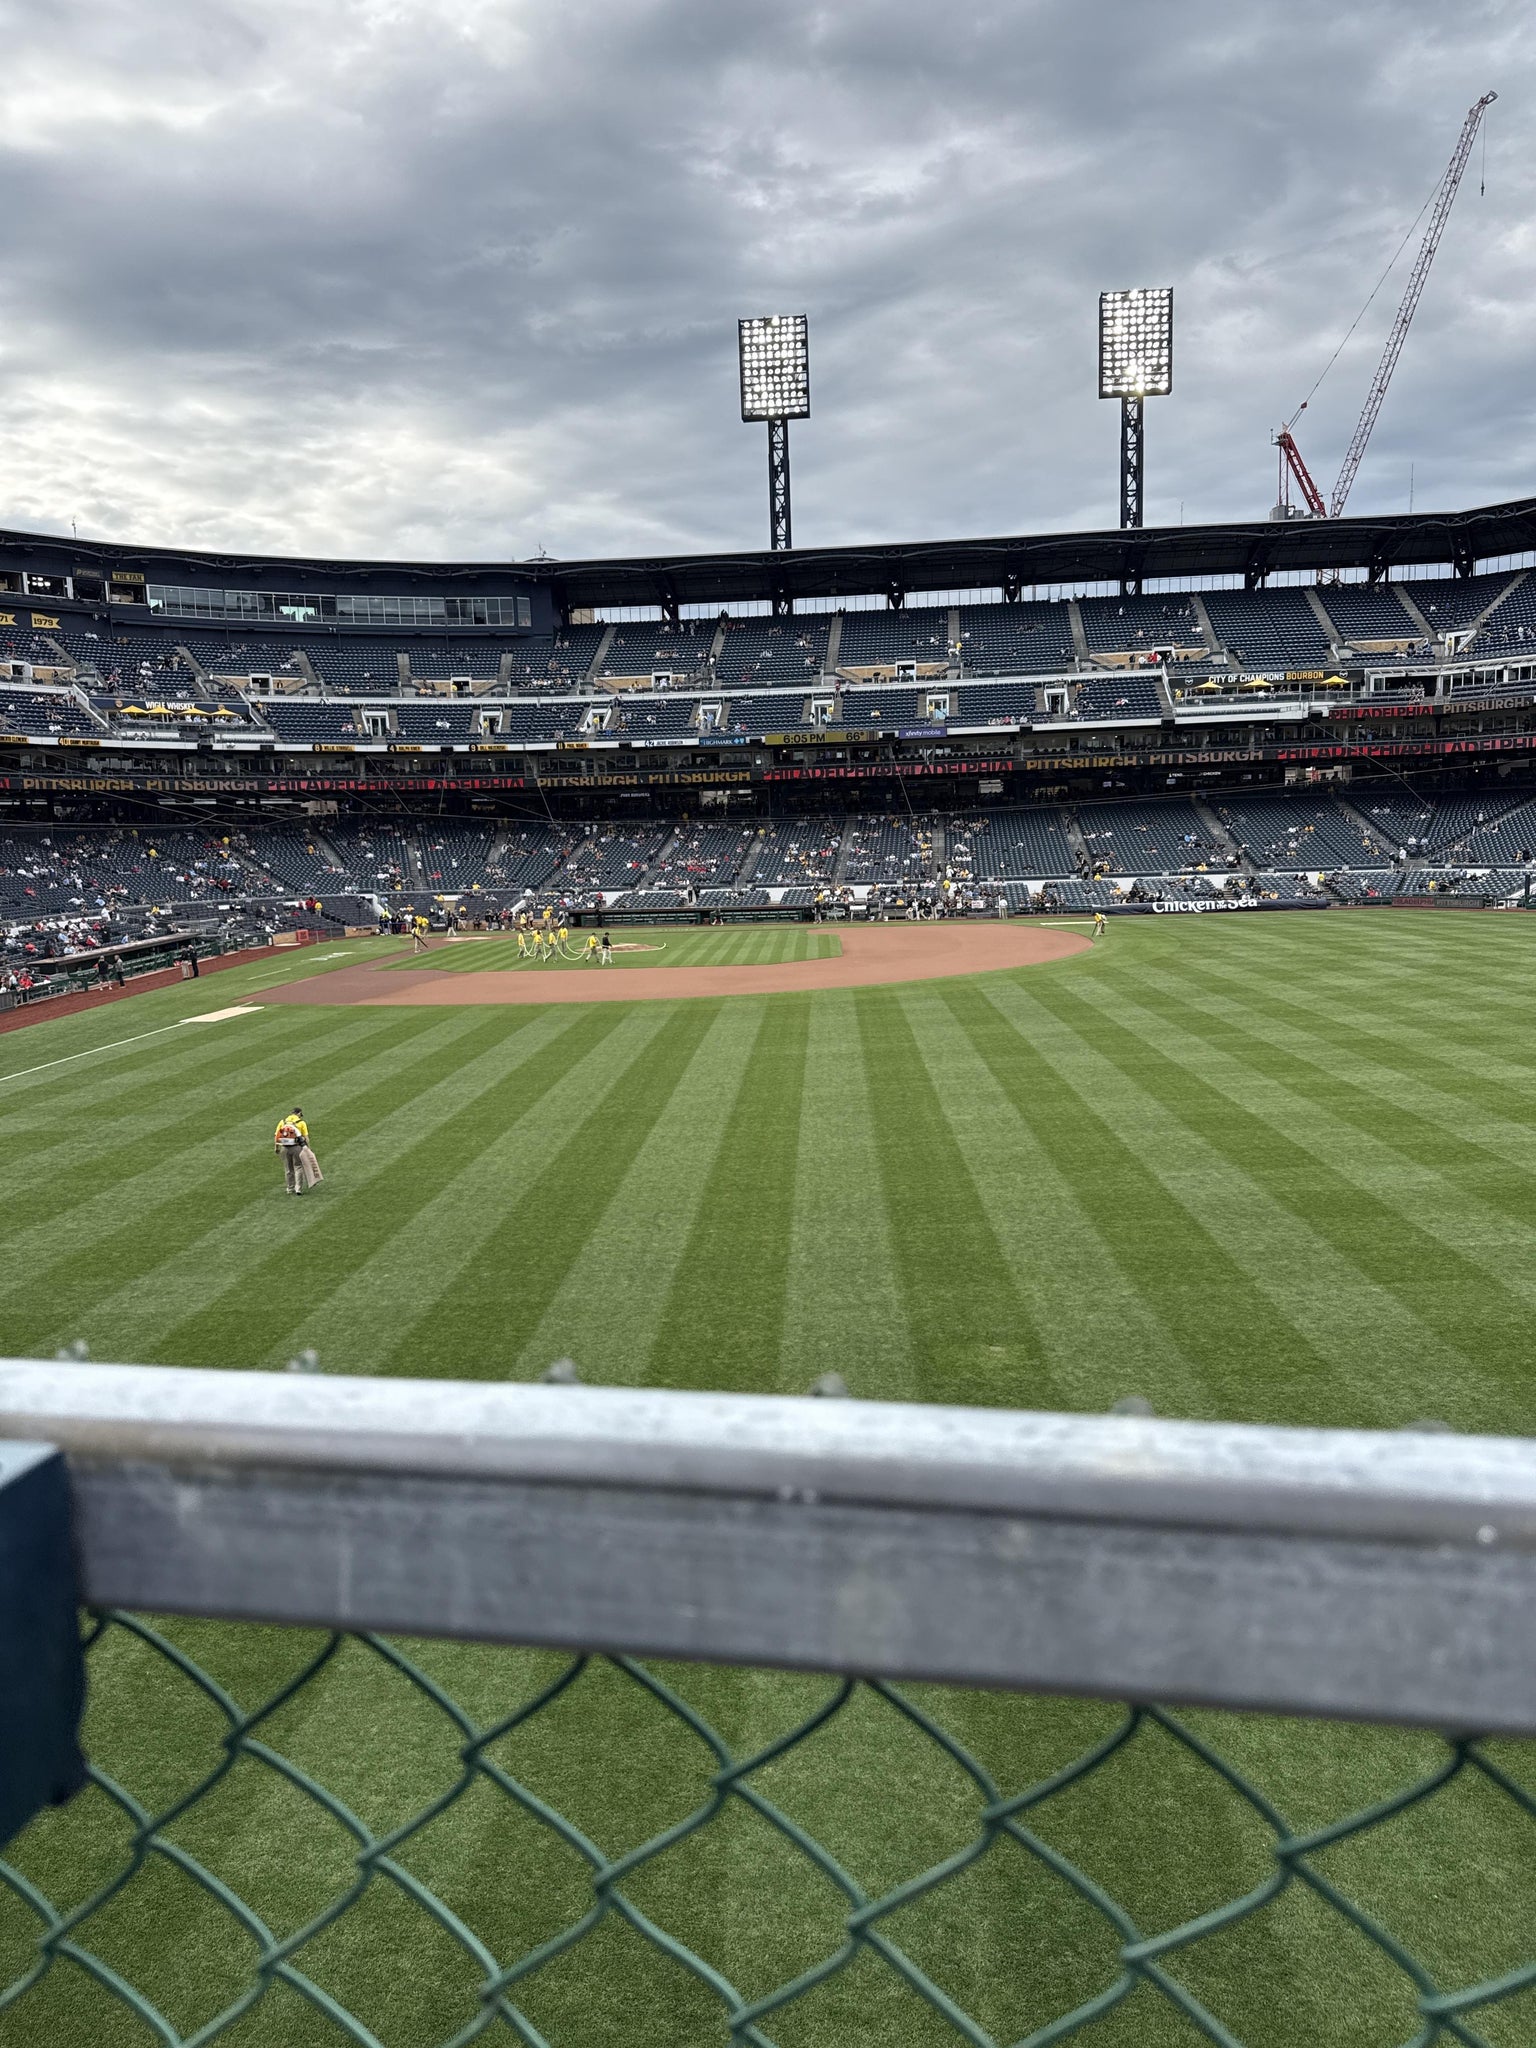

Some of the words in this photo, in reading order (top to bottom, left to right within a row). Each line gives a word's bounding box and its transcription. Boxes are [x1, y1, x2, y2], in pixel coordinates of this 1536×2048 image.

[115, 573, 128, 581] THE
[33, 617, 54, 627] 1979
[1208, 676, 1226, 684] CITY
[1227, 674, 1238, 683] OF
[1239, 672, 1285, 683] CHAMPIONS
[1286, 671, 1324, 680] BOURBON
[145, 701, 165, 710] WIGLE
[166, 701, 196, 711] WHISKEY
[1334, 705, 1432, 719] PHILADELPHIA
[1443, 697, 1525, 714] PITTSBURGH
[783, 734, 807, 744] 6:05
[810, 733, 826, 743] PM
[1149, 751, 1263, 765] PITTSBURGH
[1277, 746, 1410, 760] PHILADELPHIA
[763, 767, 884, 780] PHILADELPHIA
[1026, 756, 1137, 770] PITTSBURGH
[23, 778, 134, 791] PITTSBURGH
[146, 780, 259, 791] PITTSBURGH
[268, 779, 396, 791] PHILADELPHIA
[537, 774, 638, 787] PITTSBURGH
[648, 772, 751, 785] PITTSBURGH
[1152, 900, 1217, 913] Chicken
[1227, 898, 1258, 910] Sea
